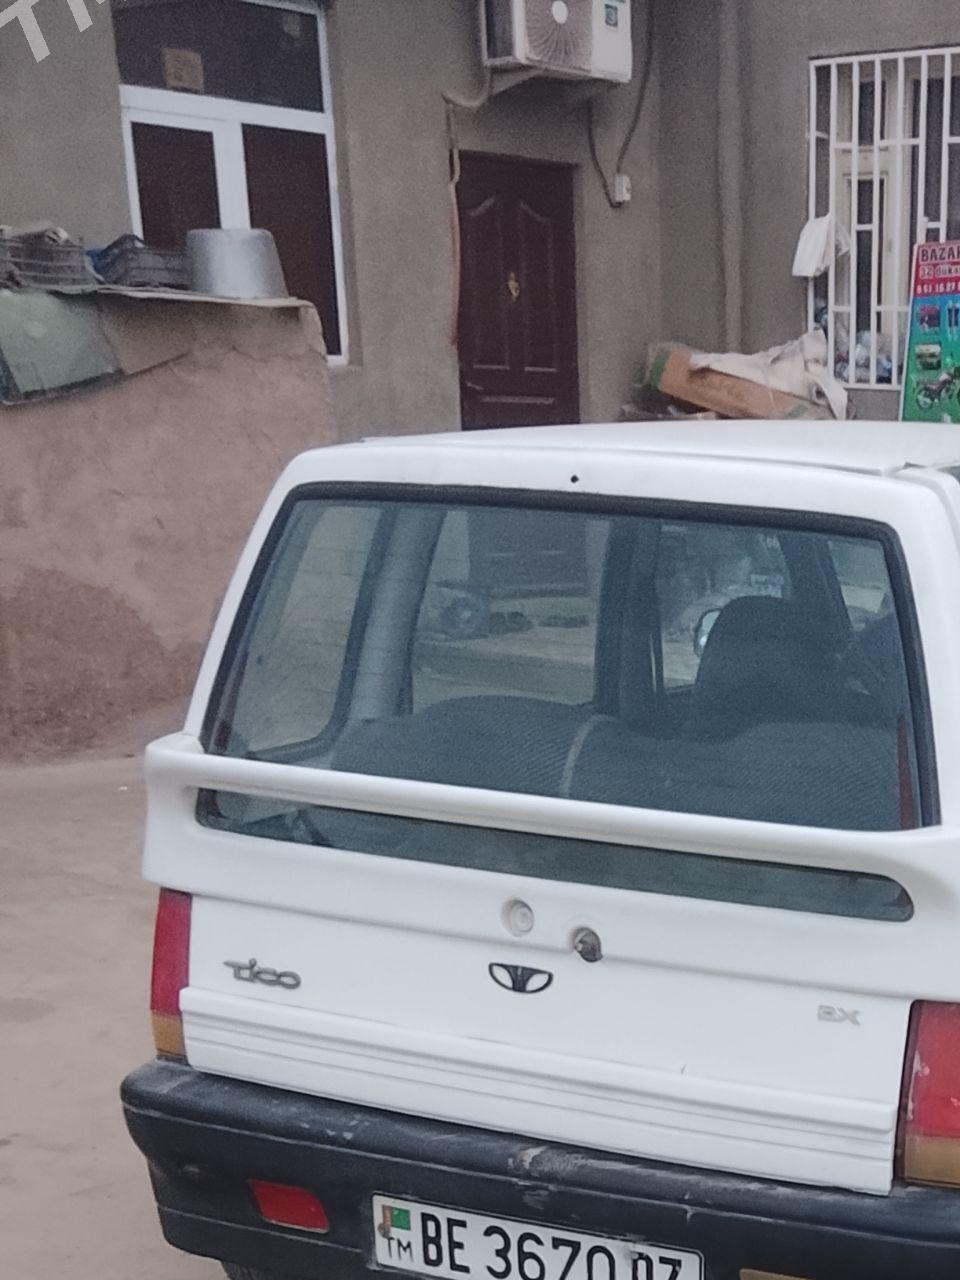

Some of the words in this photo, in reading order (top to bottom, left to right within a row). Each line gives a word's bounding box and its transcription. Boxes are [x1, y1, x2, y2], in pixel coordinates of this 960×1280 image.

[223, 957, 302, 990] tico
[386, 1237, 413, 1262] TM
[420, 1212, 470, 1274] BE
